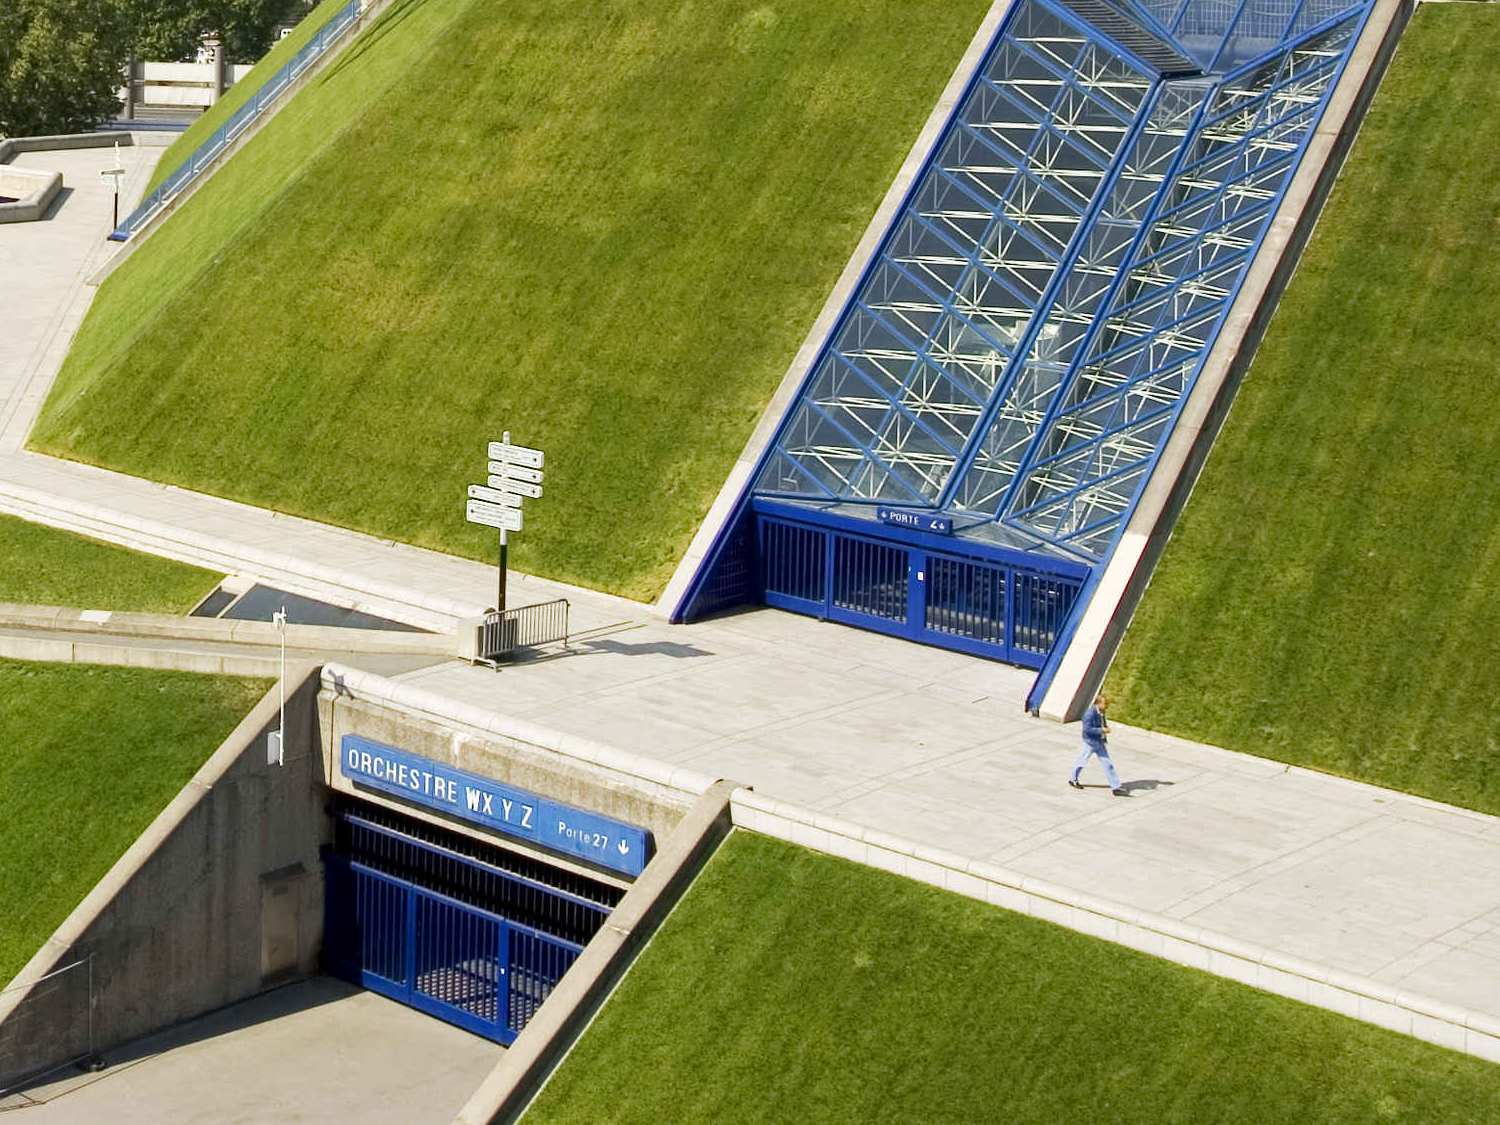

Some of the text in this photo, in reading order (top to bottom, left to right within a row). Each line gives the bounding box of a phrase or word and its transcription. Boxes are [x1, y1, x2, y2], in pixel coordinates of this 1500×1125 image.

[890, 512, 919, 525] PORTE
[348, 748, 457, 803] ORCHESTRE
[558, 821, 608, 850] Porte 27
